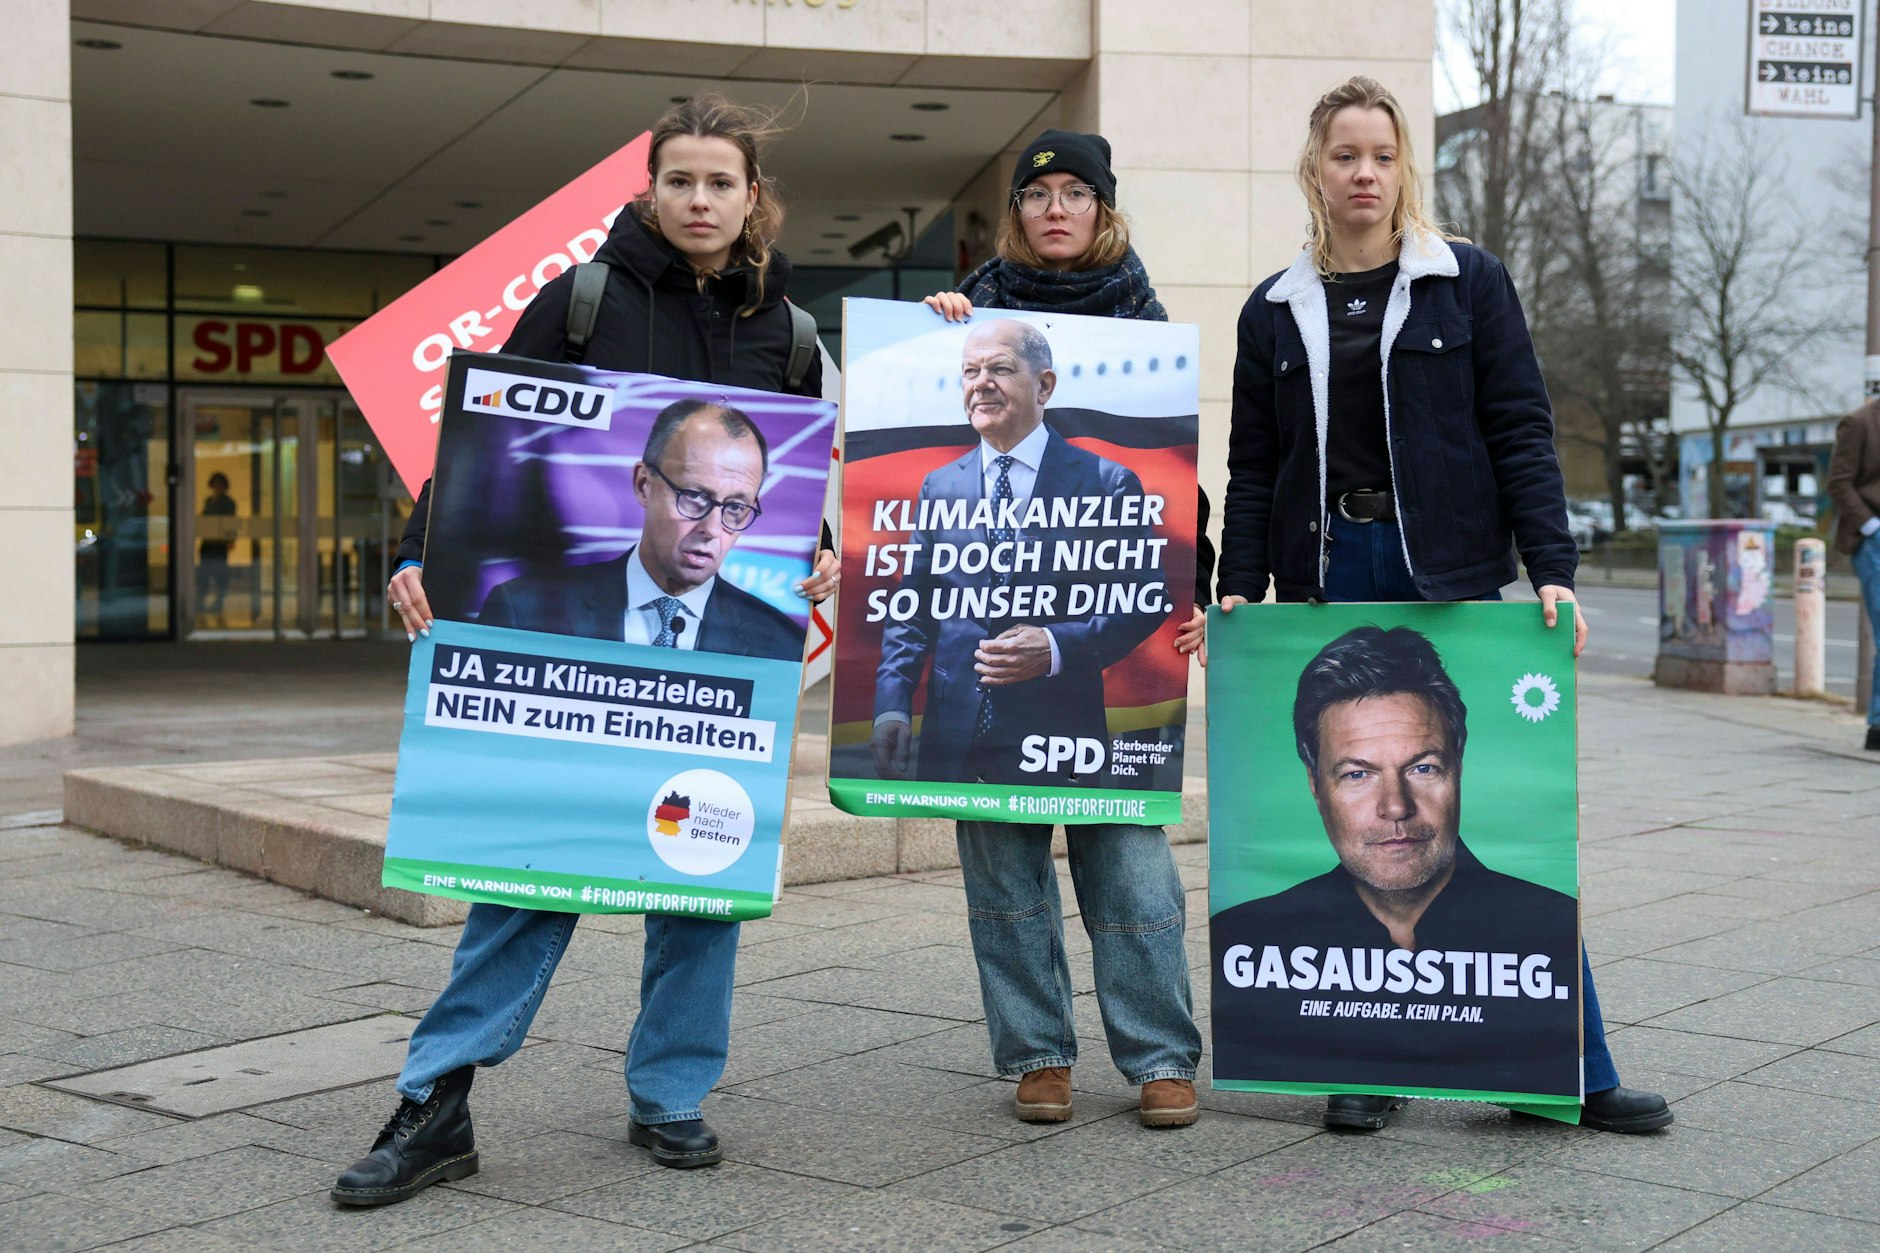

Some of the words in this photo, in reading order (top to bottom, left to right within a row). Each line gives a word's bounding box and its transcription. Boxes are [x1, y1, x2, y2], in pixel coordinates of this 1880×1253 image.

[1784, 16, 1851, 35] keine
[1767, 41, 1845, 58] CHANCE
[1783, 64, 1850, 84] keine
[1778, 87, 1831, 105] WAHL
[192, 320, 325, 375] SPD
[506, 383, 605, 421] CDU
[872, 495, 1165, 532] KLIMAKANZLER
[864, 543, 922, 577] IST
[930, 541, 1043, 575] DOCH
[1052, 538, 1168, 572] NICHT
[866, 588, 920, 622] SO
[930, 584, 1057, 619] UNSER
[1066, 581, 1174, 616] DING.
[439, 652, 485, 682] JA
[494, 663, 535, 687] zu
[543, 663, 745, 716] Klimazielen,
[435, 691, 516, 724] NEIN
[524, 706, 595, 733] zum
[604, 711, 766, 752] Einhalten.
[1019, 734, 1106, 774] SPD
[1112, 740, 1173, 753] Sterbender
[1112, 752, 1147, 764] Planet
[1149, 753, 1166, 765] für
[1111, 765, 1138, 776] Dich.
[698, 801, 741, 820] Wieder
[865, 793, 896, 805] EINE
[899, 794, 968, 807] WARNUNG
[971, 797, 1000, 809] VON
[1008, 795, 1146, 818] #FRIDAYSFORFUTURE
[694, 815, 724, 829] nach
[690, 827, 740, 846] gestern
[423, 874, 456, 888] EINE
[460, 877, 536, 896] WARNUNG
[540, 885, 572, 898] VON
[581, 886, 733, 915] #FRIDAYSFORFUTURE
[1222, 943, 1569, 1000] GASAUSSTIEG.
[1300, 1000, 1331, 1017] EINE
[1333, 1002, 1402, 1020] AUFGABE.
[1405, 1004, 1440, 1021] KEIN
[1441, 1005, 1484, 1024] PLAN.
